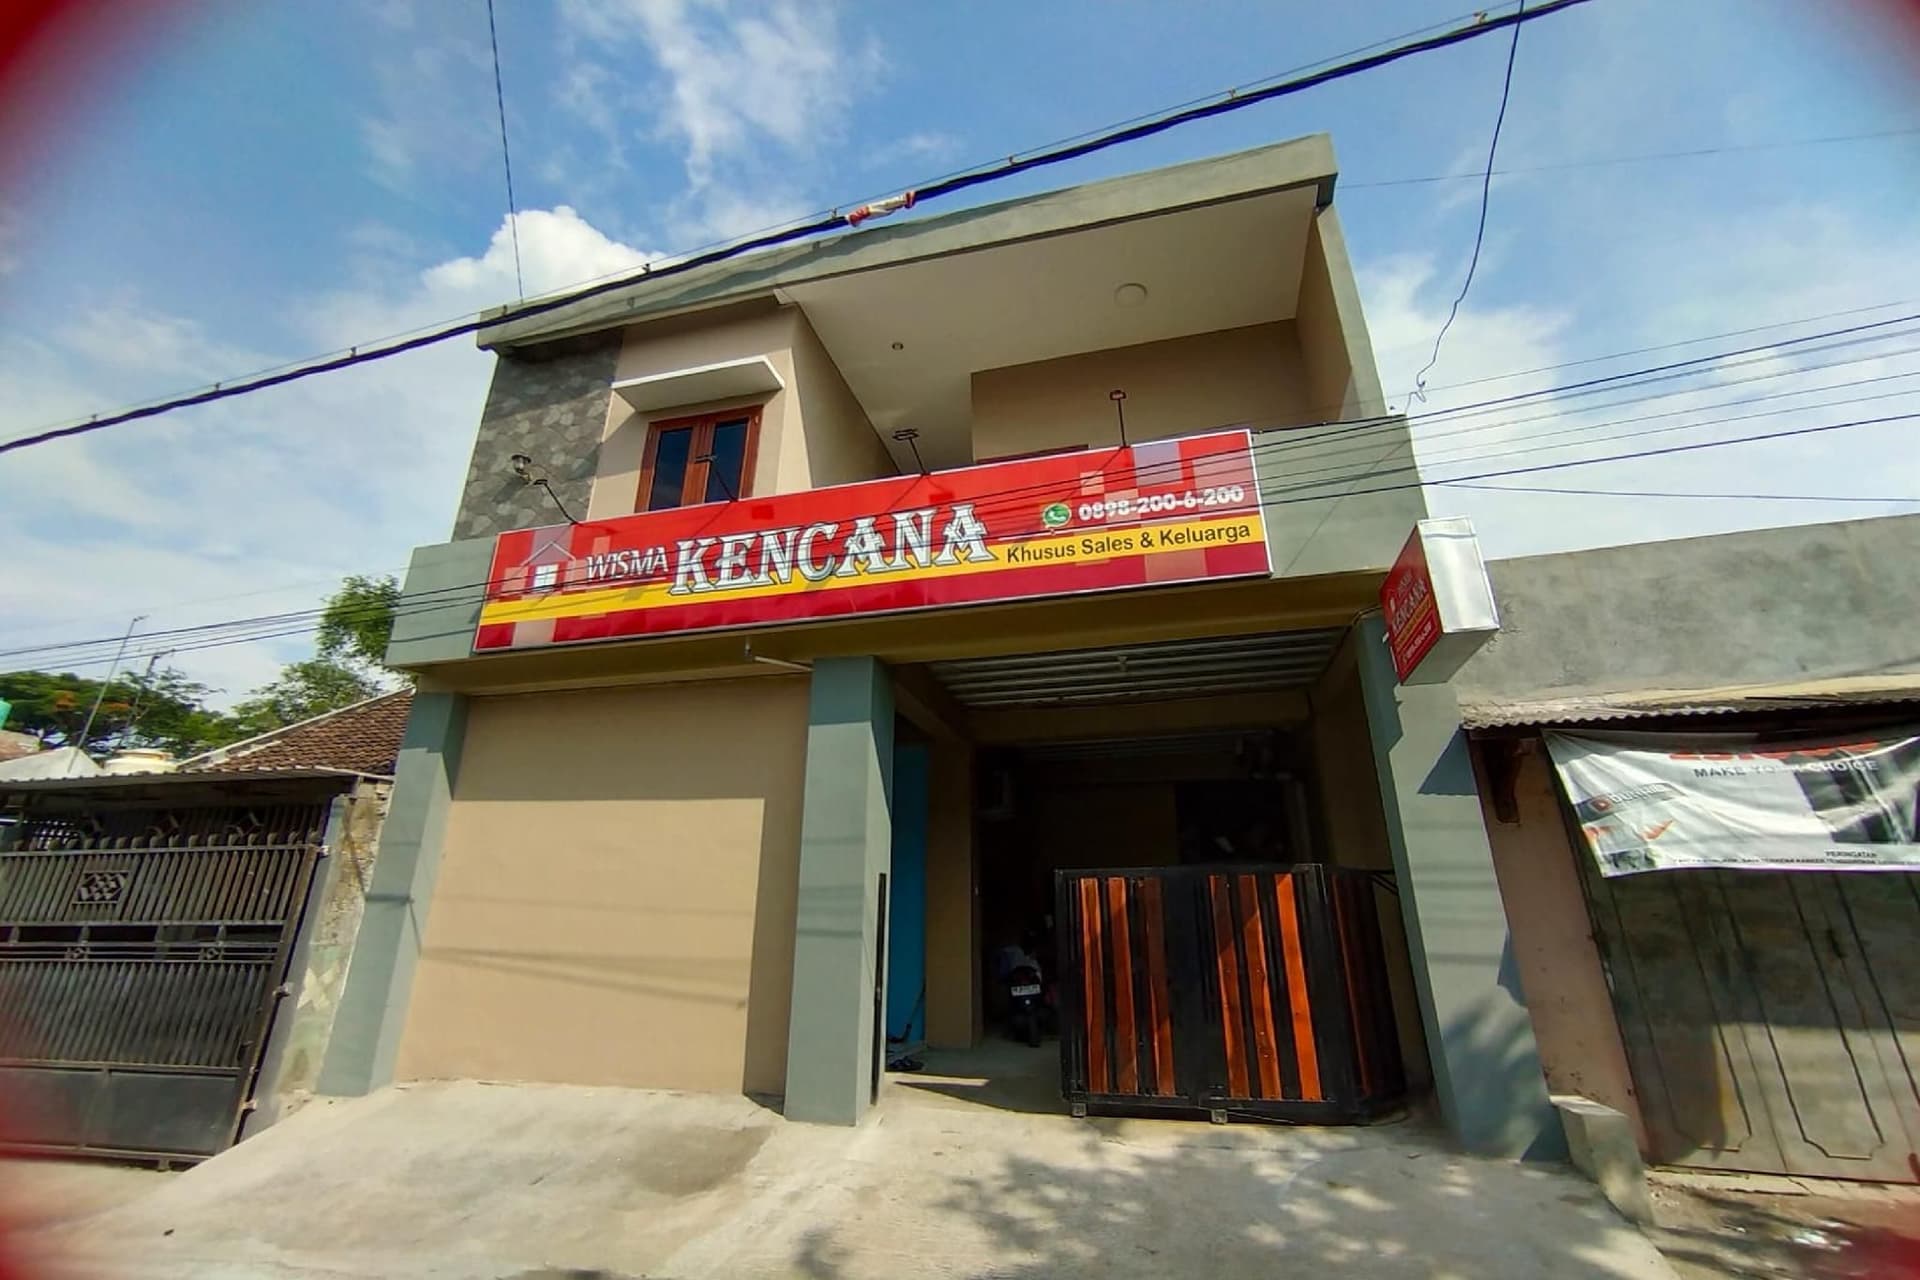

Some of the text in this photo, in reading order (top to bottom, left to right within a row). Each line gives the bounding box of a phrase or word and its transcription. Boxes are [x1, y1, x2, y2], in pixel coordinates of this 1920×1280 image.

[1078, 485, 1245, 521] 0898-200-6-200
[586, 502, 999, 596] WISMA KENCANA
[1006, 523, 1251, 564] Khusus Sales & Keluarga
[1808, 758, 1880, 773] CHOICE
